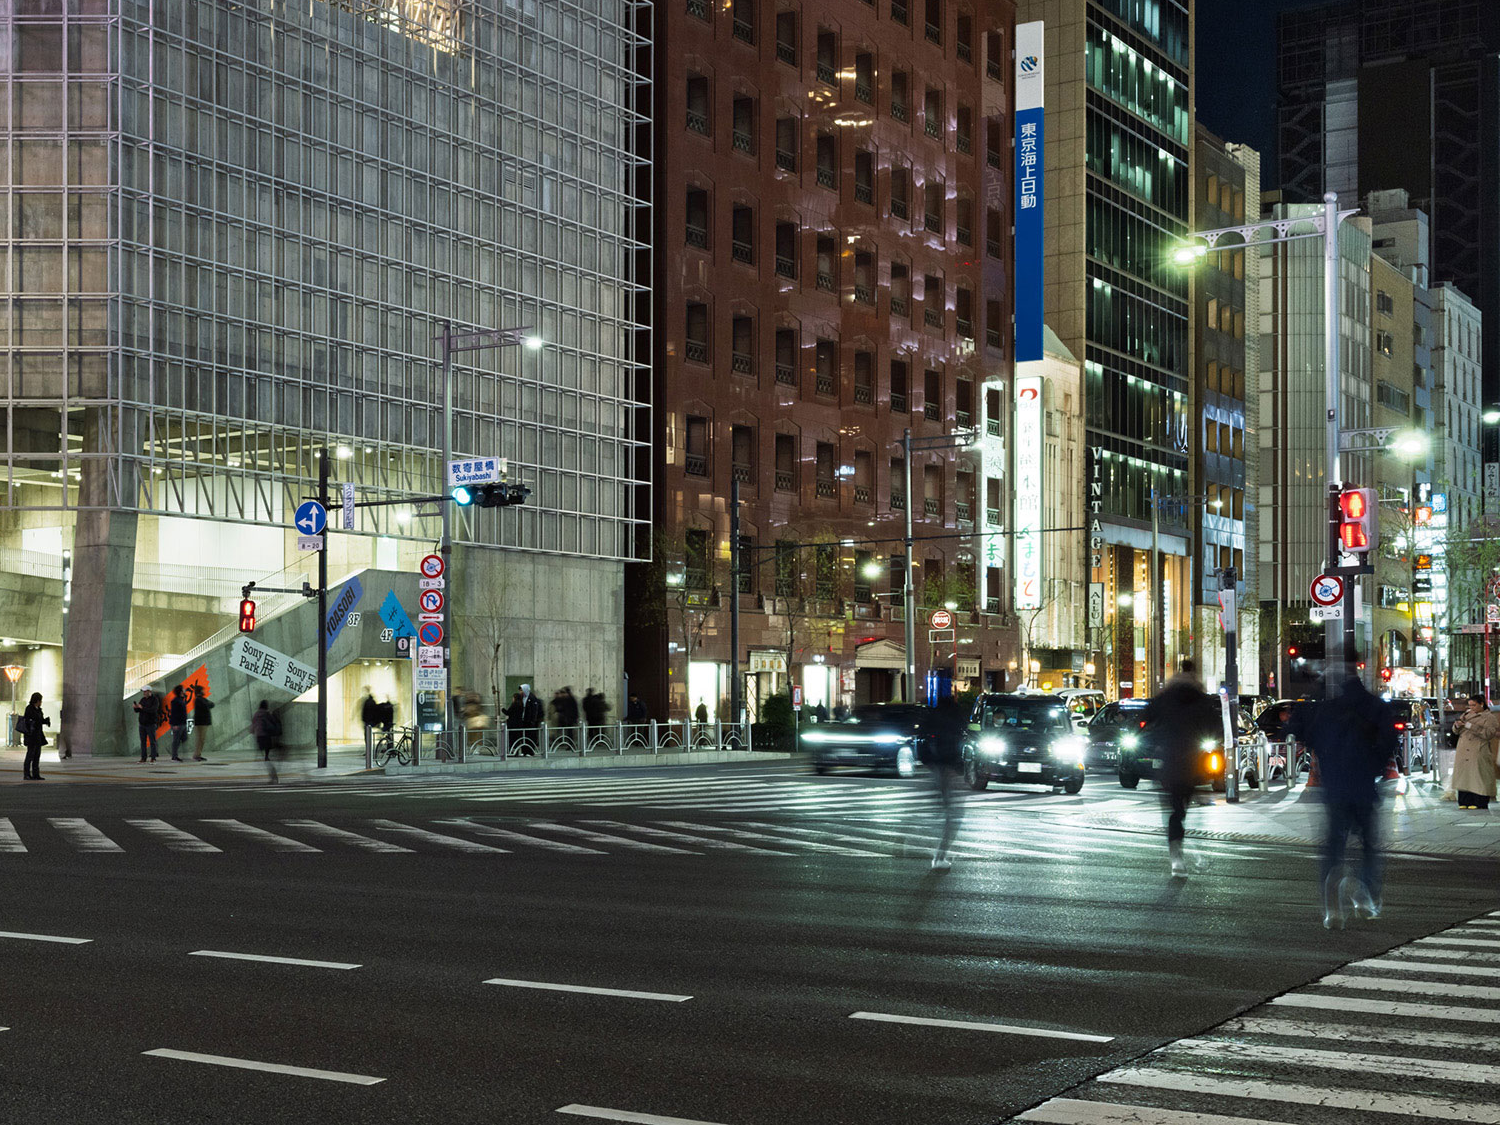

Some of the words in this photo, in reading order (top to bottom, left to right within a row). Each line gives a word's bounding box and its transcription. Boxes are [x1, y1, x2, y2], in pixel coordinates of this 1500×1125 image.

[1021, 123, 1037, 209] 東京海上日動
[451, 459, 495, 475] 数寄屋橋
[455, 472, 492, 483] Sukiyabashi
[1091, 447, 1102, 567] VINTAGE
[1019, 523, 1037, 597] くまもと
[326, 586, 356, 637] YOASOBI
[1091, 591, 1100, 620] ALLU
[348, 614, 360, 626] 3F
[381, 629, 393, 642] 4F
[242, 640, 264, 661] Sony
[239, 656, 260, 675] Park
[259, 654, 277, 681] 展
[286, 661, 308, 681] Sony
[284, 675, 303, 693] Park
